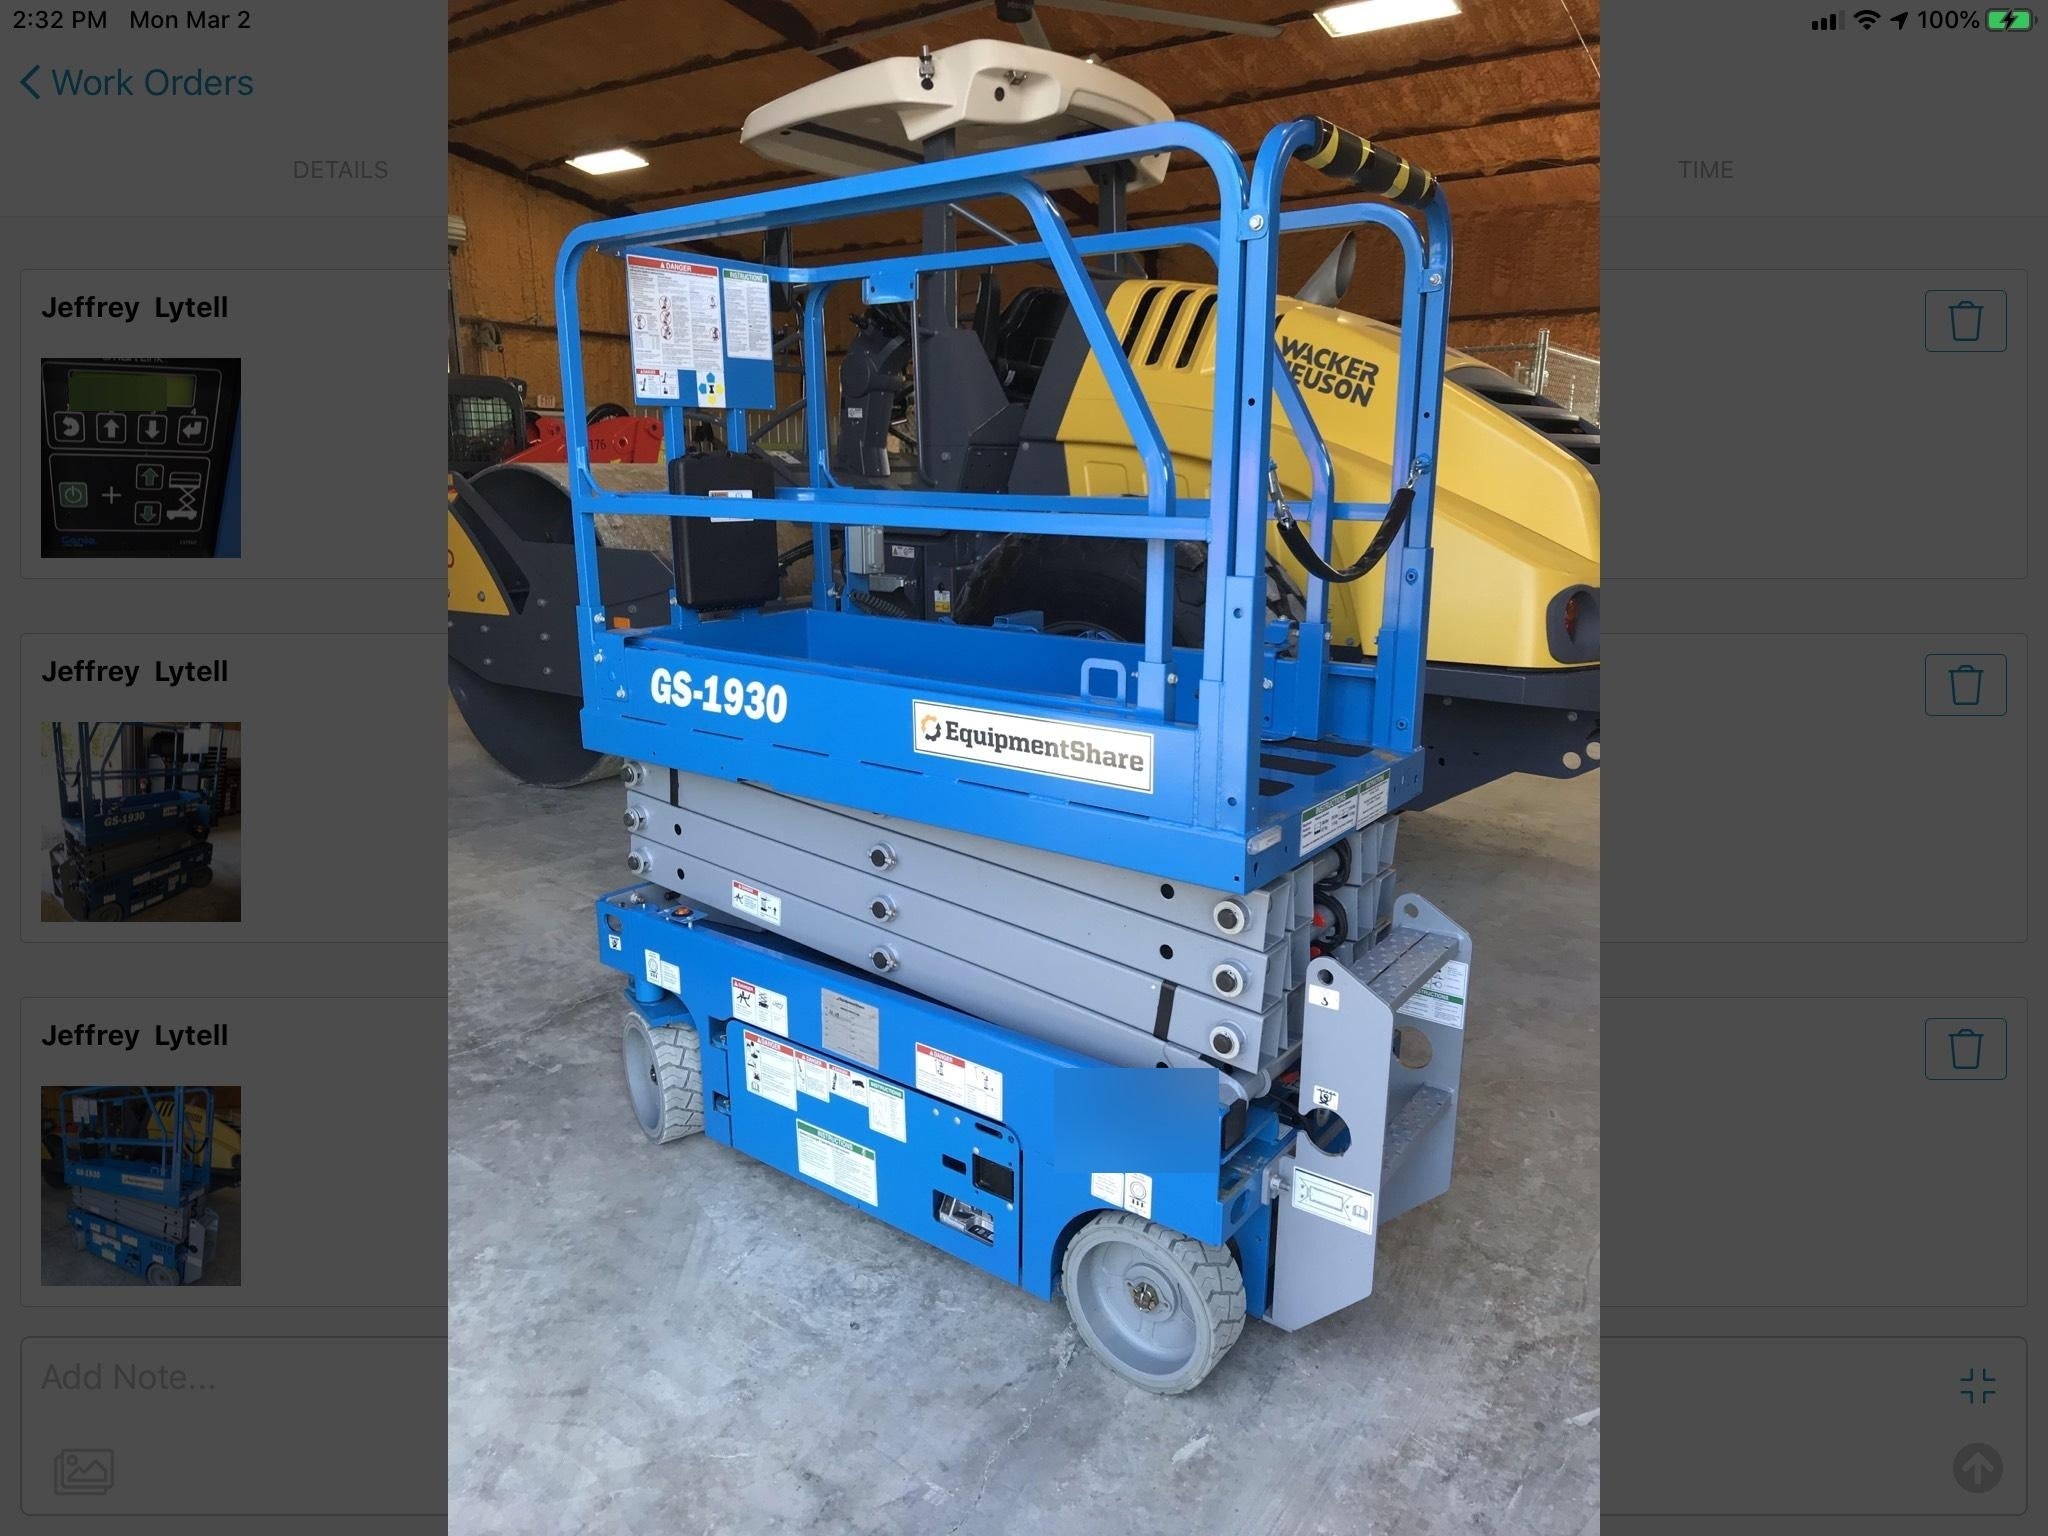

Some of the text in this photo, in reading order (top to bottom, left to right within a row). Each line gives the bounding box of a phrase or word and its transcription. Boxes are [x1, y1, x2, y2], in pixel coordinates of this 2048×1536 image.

[12, 11, 107, 29] 2:32 PM
[130, 11, 251, 29] Mon Mar 2
[1918, 10, 1980, 30] 100%
[52, 69, 254, 96] Work Orders
[293, 161, 389, 179] DETAILS
[1678, 161, 1734, 179] TIME
[42, 296, 228, 324] Jeffrey Lytell
[1281, 336, 1380, 386] WACKER
[42, 660, 228, 688] Jeffrey Lytell
[650, 667, 789, 724] GS-1930
[945, 719, 1145, 773] EquipmentShare
[42, 1024, 228, 1052] Jeffrey Lytell
[41, 1364, 215, 1390] Add Note...
